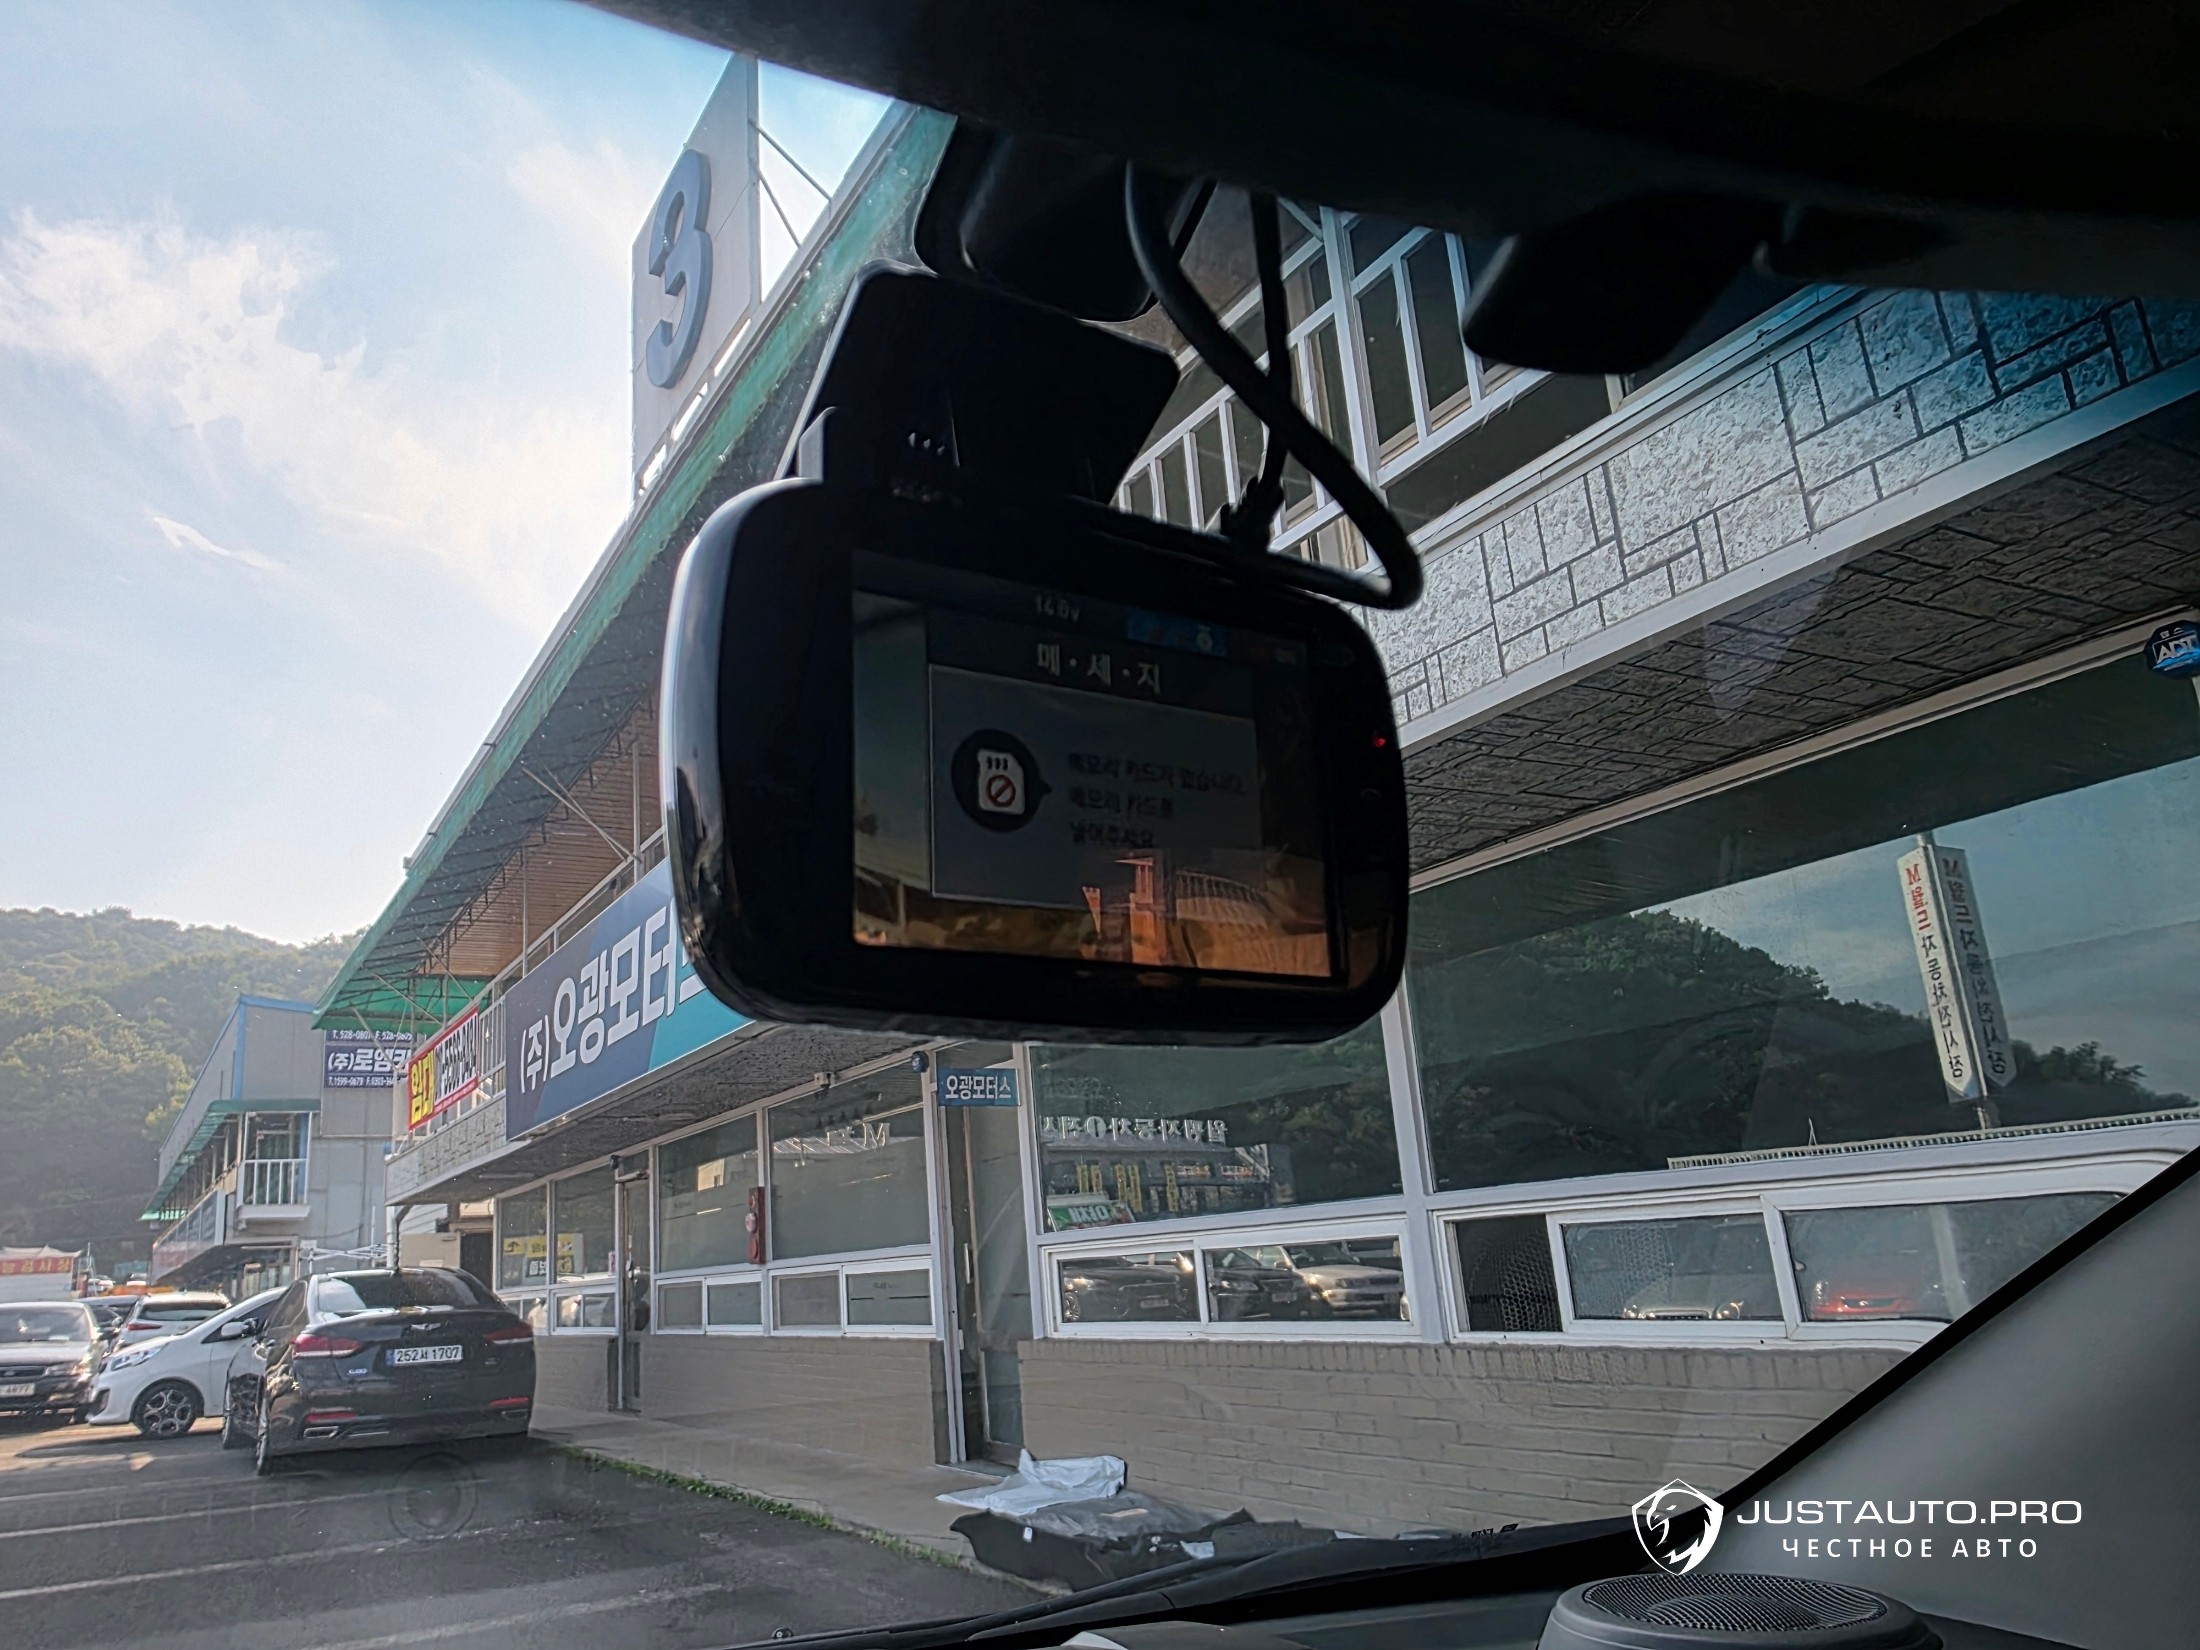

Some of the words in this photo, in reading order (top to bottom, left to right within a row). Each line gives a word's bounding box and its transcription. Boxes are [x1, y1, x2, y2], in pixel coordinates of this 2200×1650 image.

[646, 149, 713, 390] 3
[2157, 634, 2197, 664] ADT
[945, 1075, 1011, 1100] 오광모터스
[432, 1346, 460, 1360] 1707
